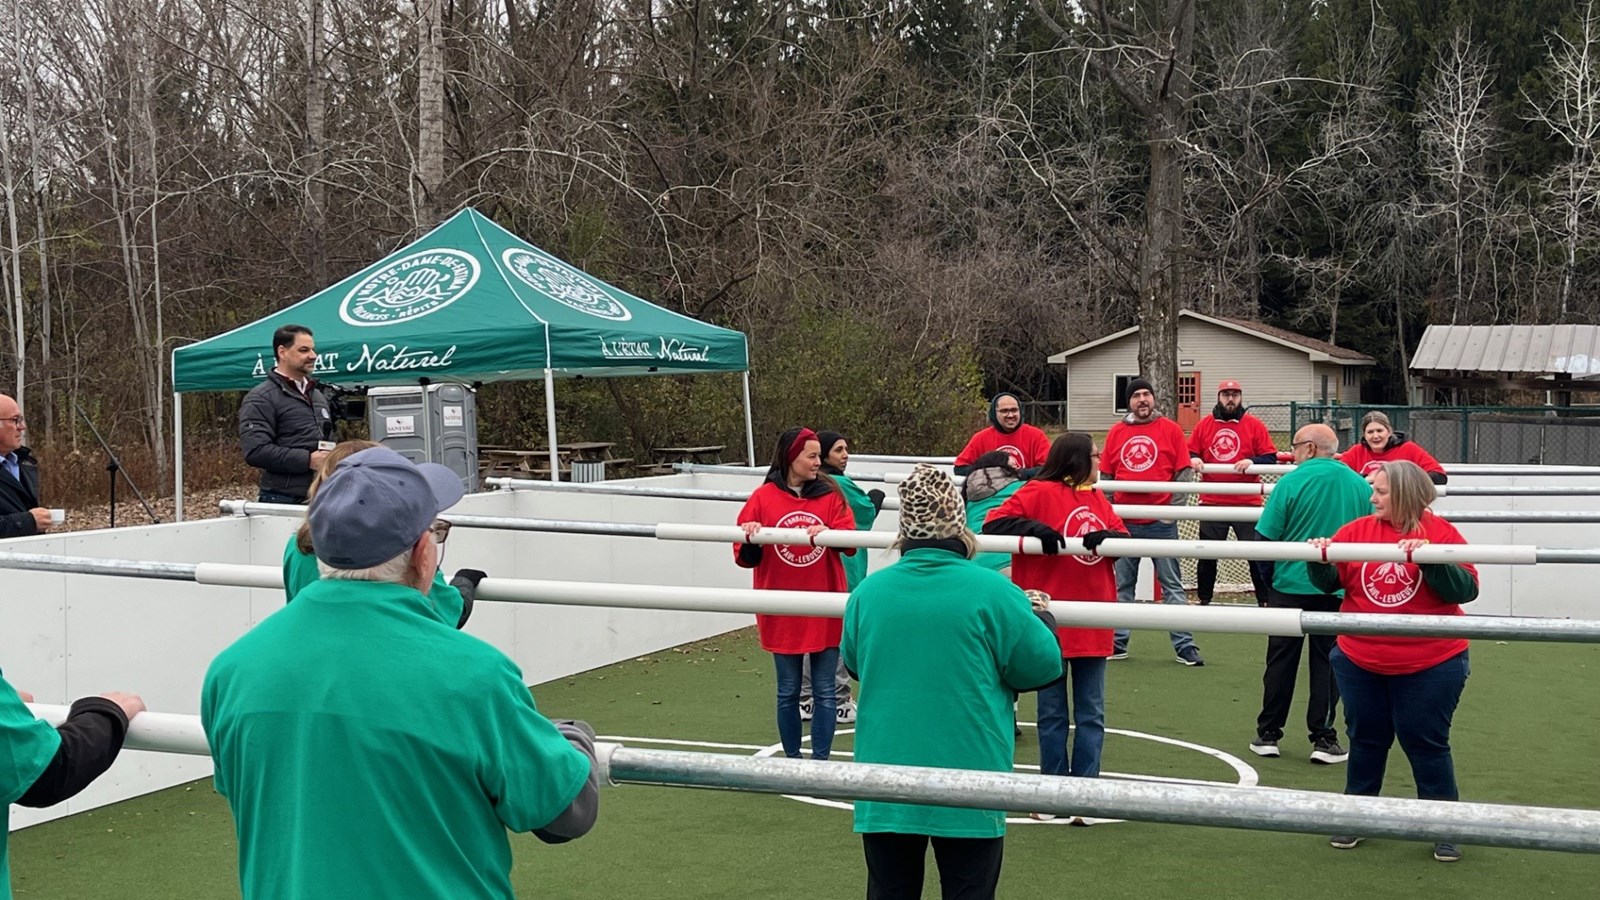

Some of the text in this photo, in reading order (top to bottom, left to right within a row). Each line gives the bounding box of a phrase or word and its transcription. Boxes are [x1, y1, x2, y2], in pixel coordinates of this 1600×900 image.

[399, 300, 439, 318] RÉPITS
[252, 353, 267, 375] À
[347, 344, 457, 373] Naturel
[657, 336, 709, 361] Naturel
[1366, 582, 1415, 604] PAUL-LEBOEUF
